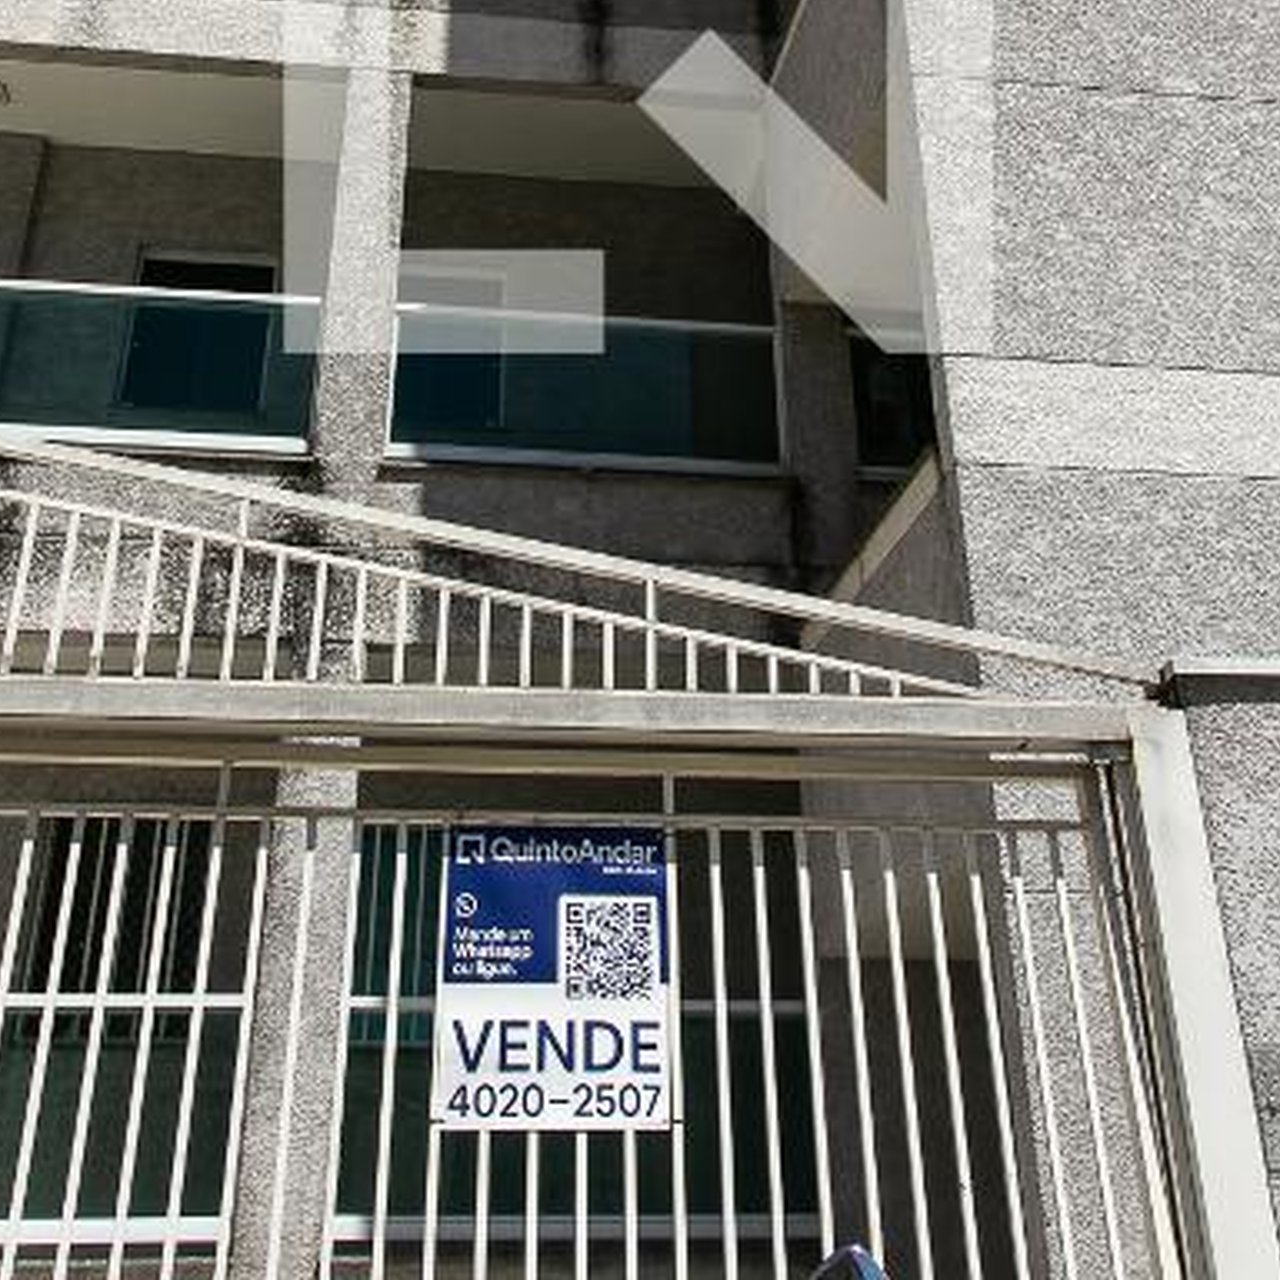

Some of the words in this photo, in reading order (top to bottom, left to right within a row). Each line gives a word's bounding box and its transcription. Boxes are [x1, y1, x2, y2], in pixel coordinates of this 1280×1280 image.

[490, 836, 658, 865] QuintoAndar
[452, 1019, 661, 1074] VENDE
[447, 1082, 662, 1118] 4020-2507
